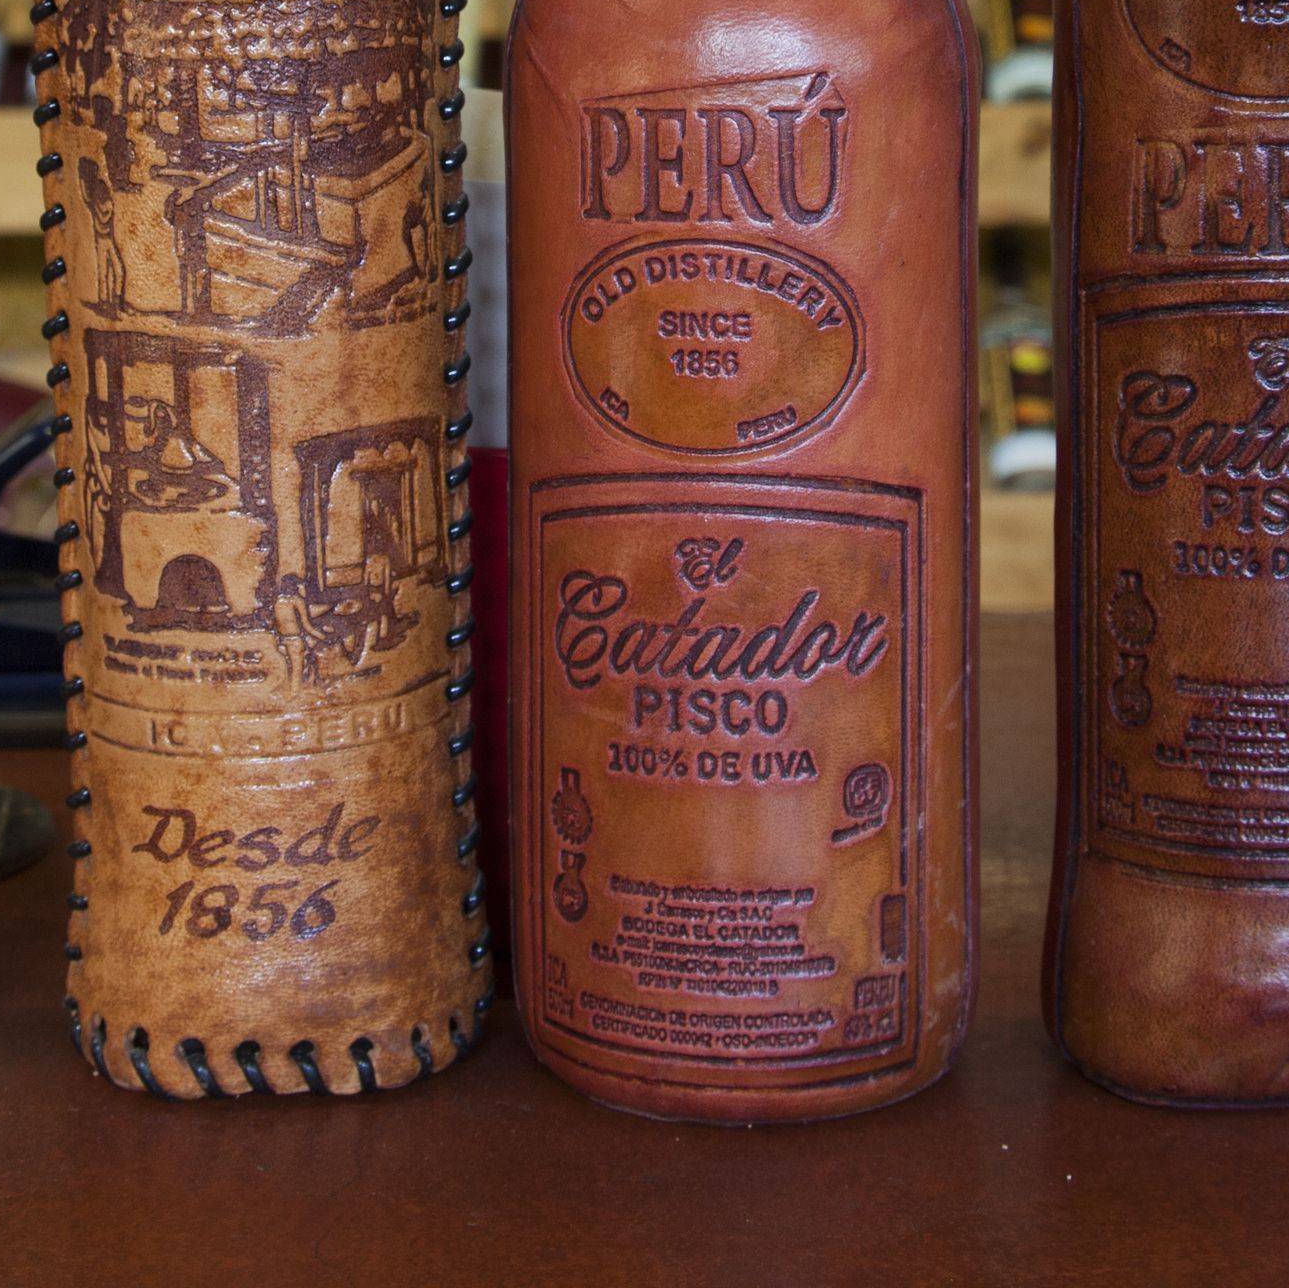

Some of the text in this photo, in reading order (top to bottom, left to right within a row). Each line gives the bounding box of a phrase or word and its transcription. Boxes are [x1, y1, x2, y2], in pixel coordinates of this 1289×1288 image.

[582, 71, 847, 226] PERÚ
[580, 253, 844, 330] OLD DISTILLERY
[658, 310, 752, 341] SINCE
[670, 349, 740, 377] 1856
[675, 537, 744, 591] El
[1173, 540, 1261, 579] 100%
[556, 570, 889, 690] Catador
[633, 685, 789, 737] PISCO
[608, 742, 818, 783] 100% DE UVA
[132, 801, 382, 872] Desde
[159, 878, 341, 941] 1856
[621, 915, 800, 943] BODEGA EL CATADOR
